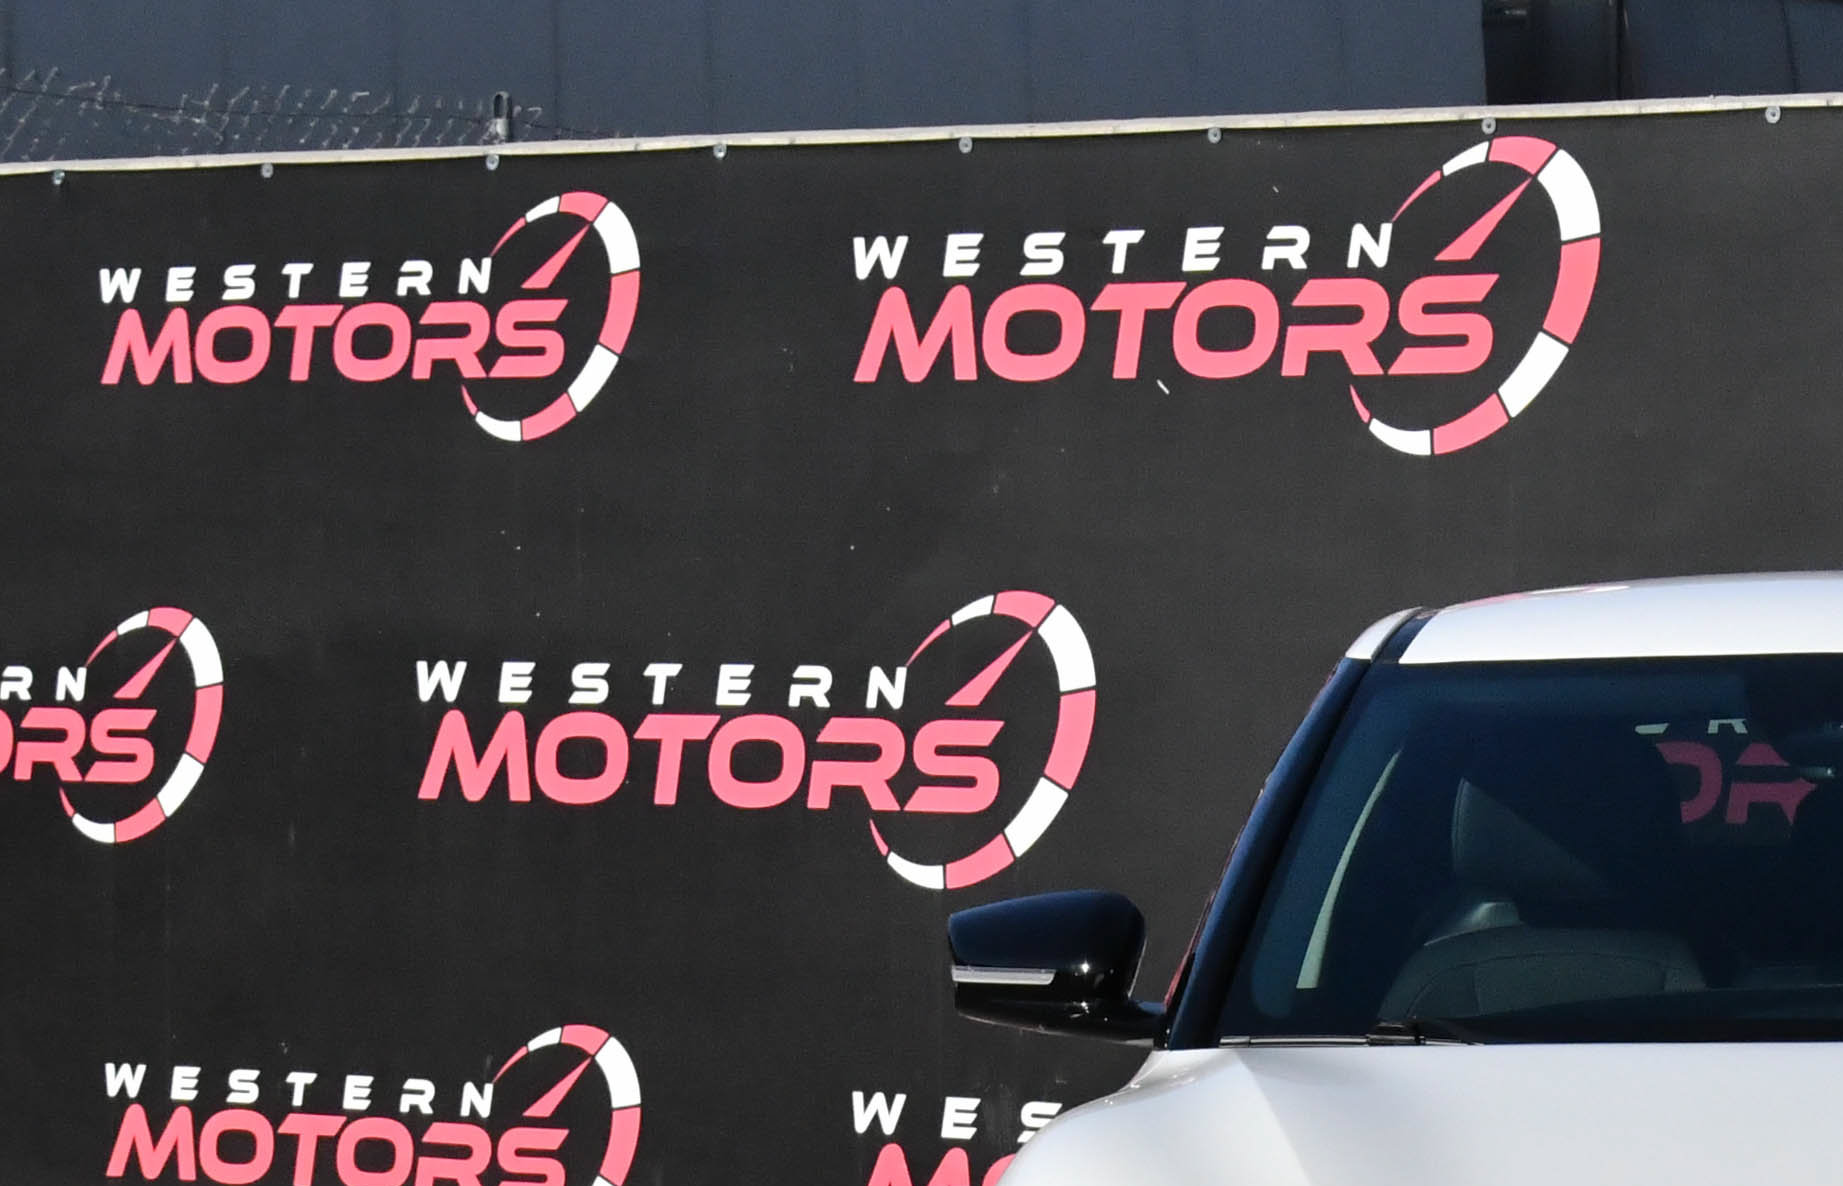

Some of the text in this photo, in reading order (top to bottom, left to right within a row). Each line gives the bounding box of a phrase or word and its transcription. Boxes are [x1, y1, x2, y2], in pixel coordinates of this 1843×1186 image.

[99, 261, 492, 304] WESTERN
[853, 222, 1393, 281] WESTERN
[101, 298, 568, 386] MOTORS
[853, 273, 1499, 383] MOTORS
[416, 660, 909, 710] WESTERN
[0, 706, 157, 784] RS
[418, 708, 1004, 814] MOTORS
[105, 1062, 495, 1119] WESTERN
